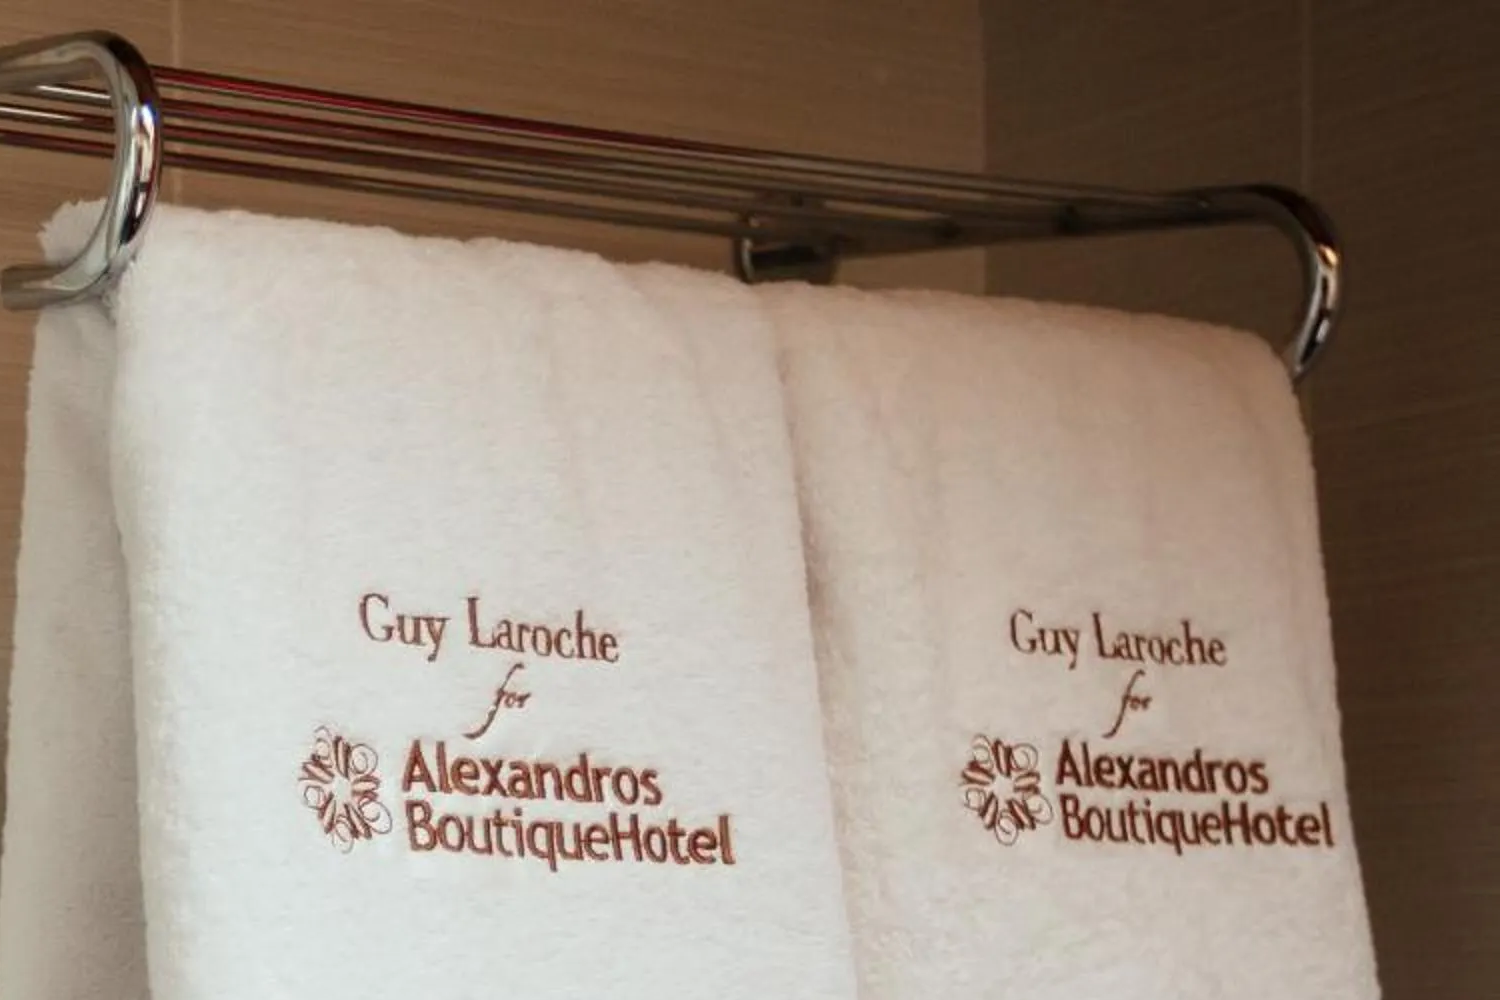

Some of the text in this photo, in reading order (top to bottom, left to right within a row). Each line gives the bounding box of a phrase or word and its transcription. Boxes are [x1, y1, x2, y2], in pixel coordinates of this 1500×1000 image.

[357, 593, 620, 664] Guy Laroche
[1009, 609, 1228, 670] Guy Laroche
[463, 663, 531, 740] for
[1102, 670, 1153, 739] for
[401, 739, 663, 807] Alexandros
[1055, 739, 1269, 795] Alexandros
[405, 800, 737, 872] BoutiqueHotel
[1060, 794, 1335, 856] BoutiqueHotel
